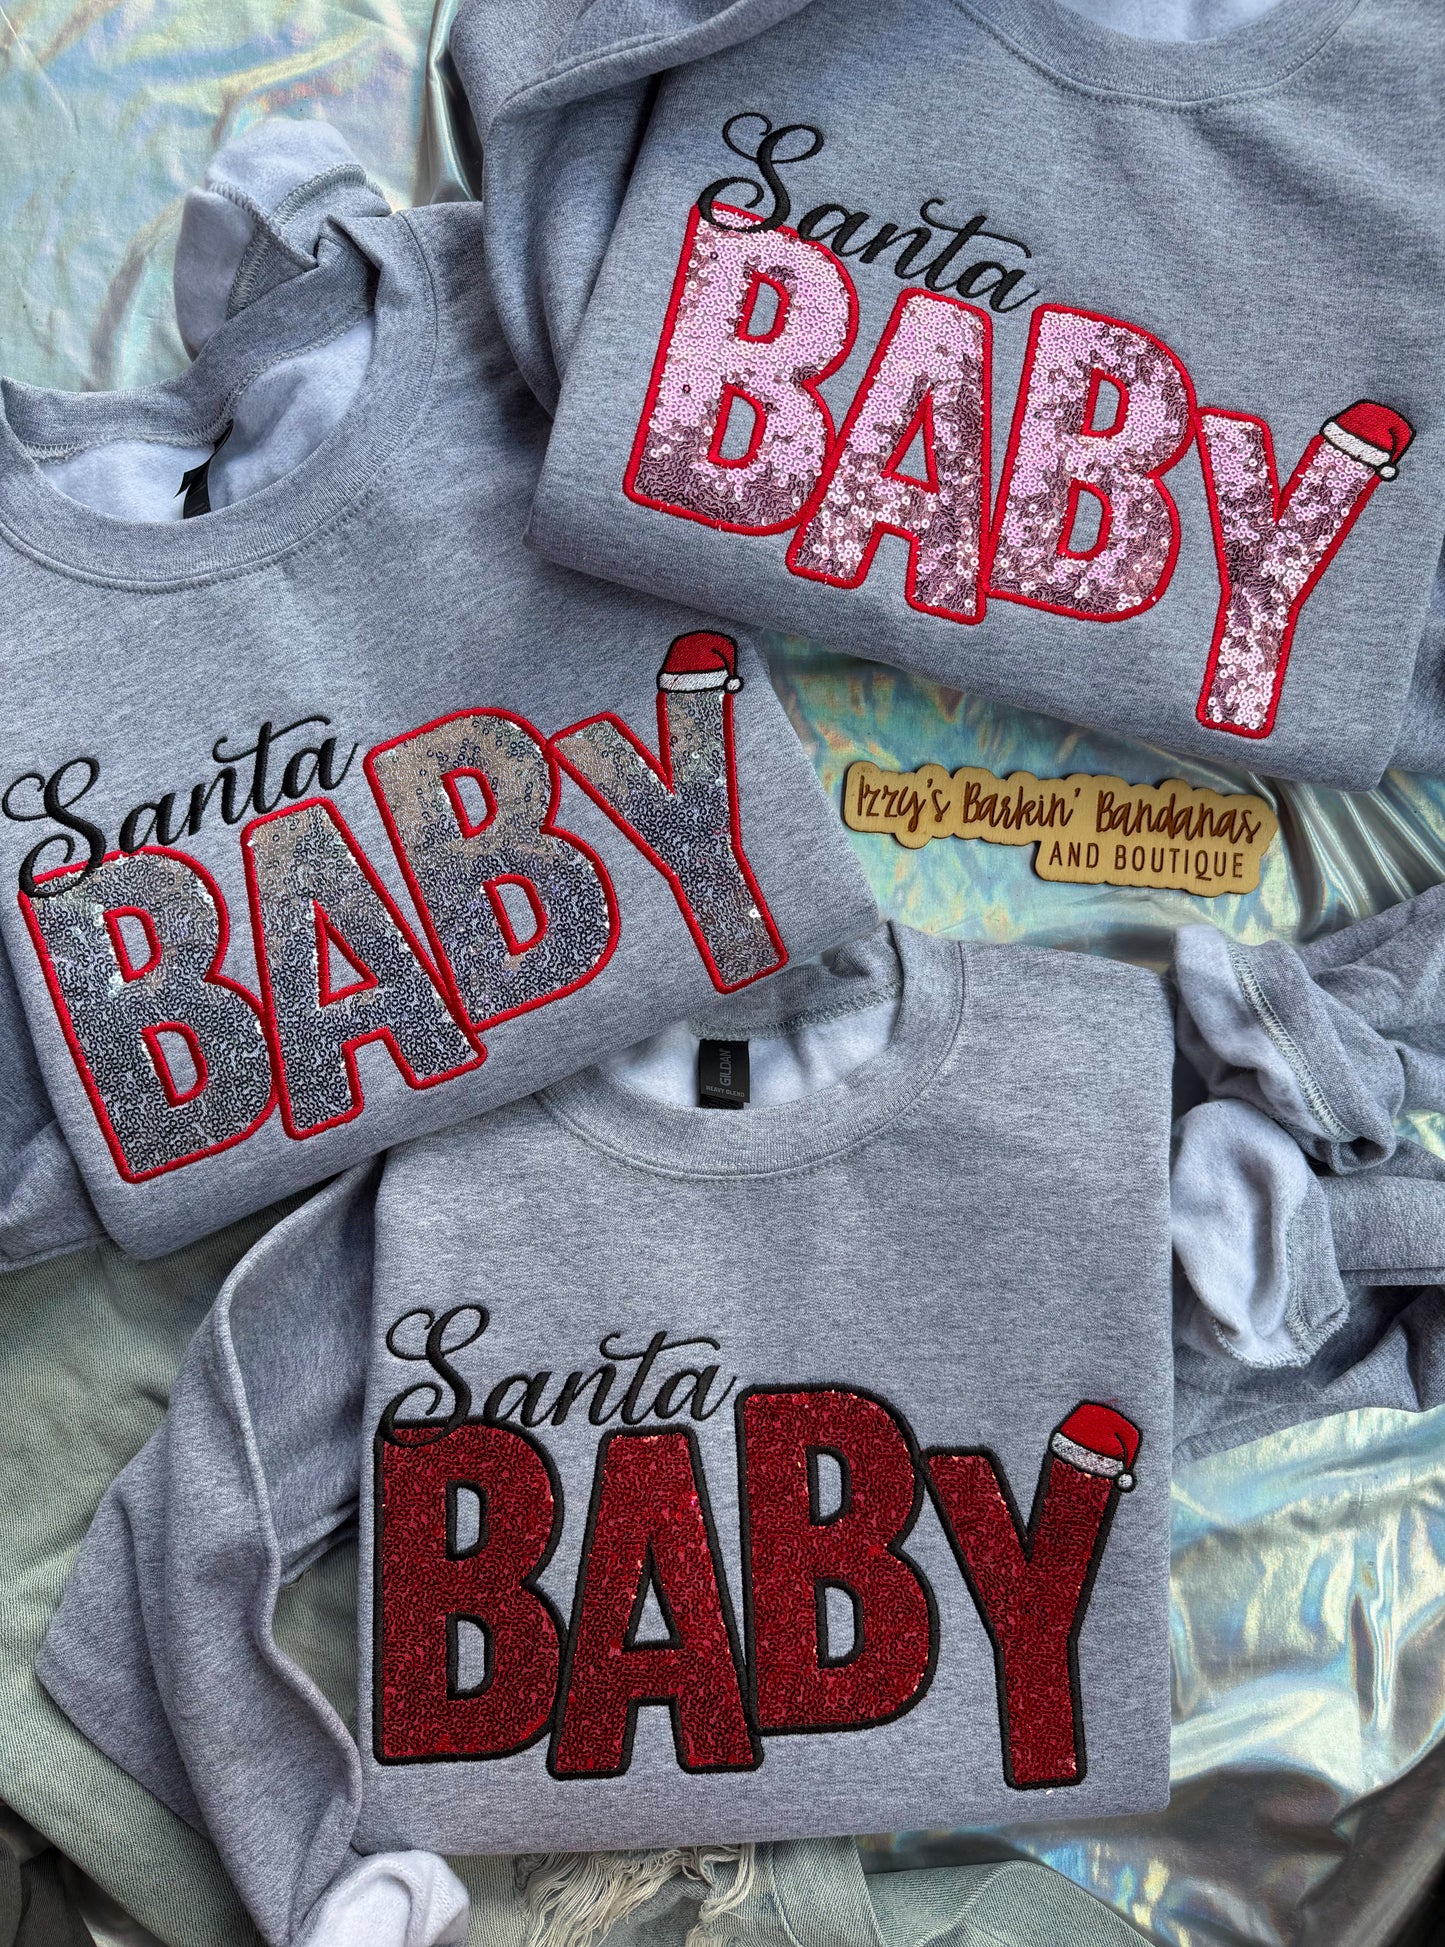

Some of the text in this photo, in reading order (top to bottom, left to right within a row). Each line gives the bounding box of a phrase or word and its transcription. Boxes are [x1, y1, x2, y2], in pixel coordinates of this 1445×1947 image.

[697, 111, 1040, 313] Santa
[621, 200, 1386, 740] BABY
[1, 714, 360, 899] Santa
[856, 774, 1262, 844] Izzy's Barkin' Bandanas
[1048, 840, 1245, 882] AND BOUTIQUE
[17, 690, 789, 1185] BABY
[705, 1085, 745, 1098] HEAVY BLEND
[719, 1049, 732, 1086] GILDAN
[377, 1303, 737, 1447] Santa
[372, 1381, 1124, 1791] BABY
